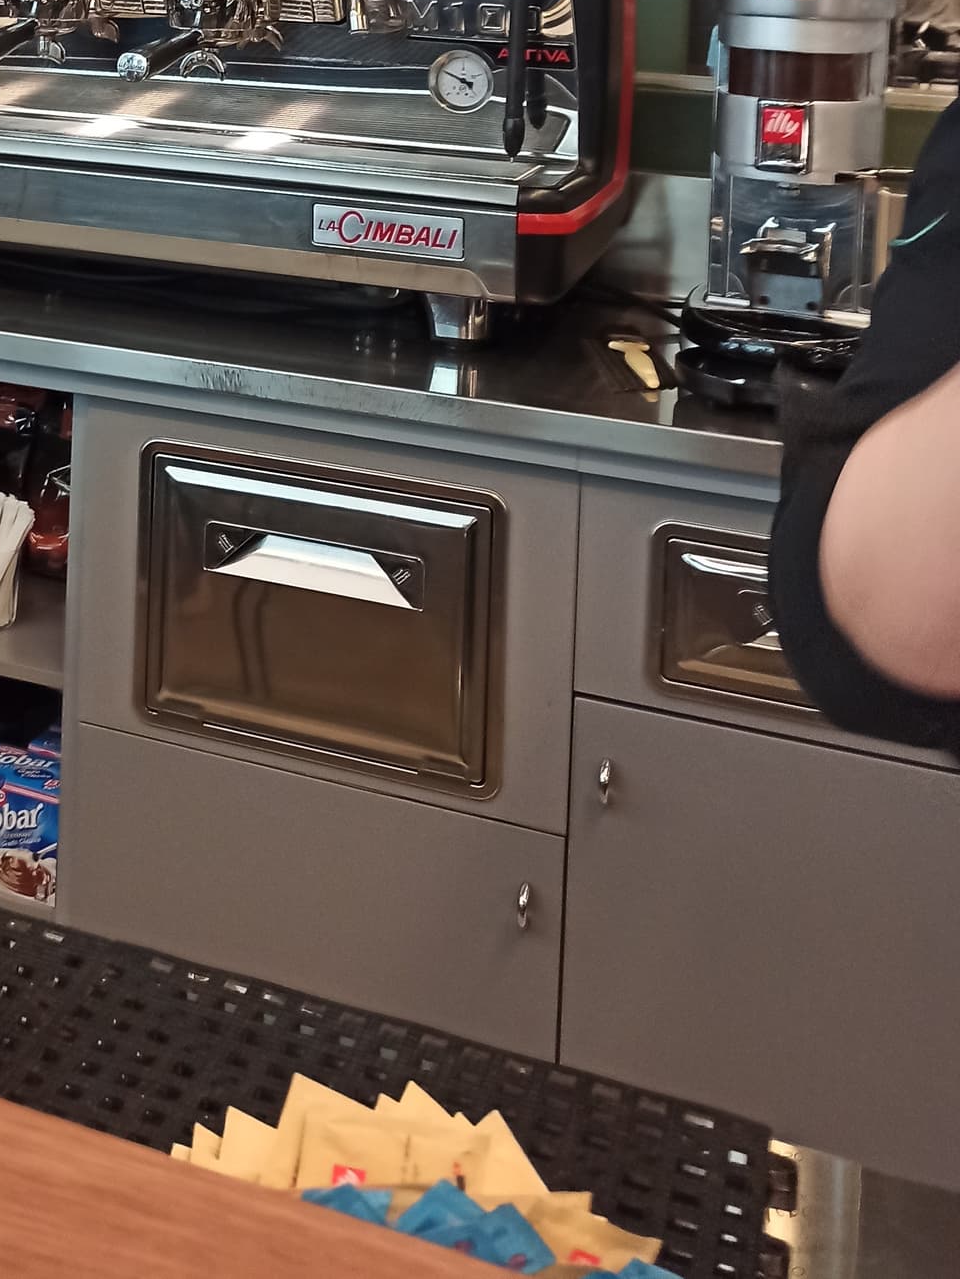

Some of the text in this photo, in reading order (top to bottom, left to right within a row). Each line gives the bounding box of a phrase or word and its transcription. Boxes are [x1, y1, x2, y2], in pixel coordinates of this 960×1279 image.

[497, 48, 571, 63] ATIVA
[765, 112, 800, 139] illy
[318, 210, 458, 250] LA CIMBALI
